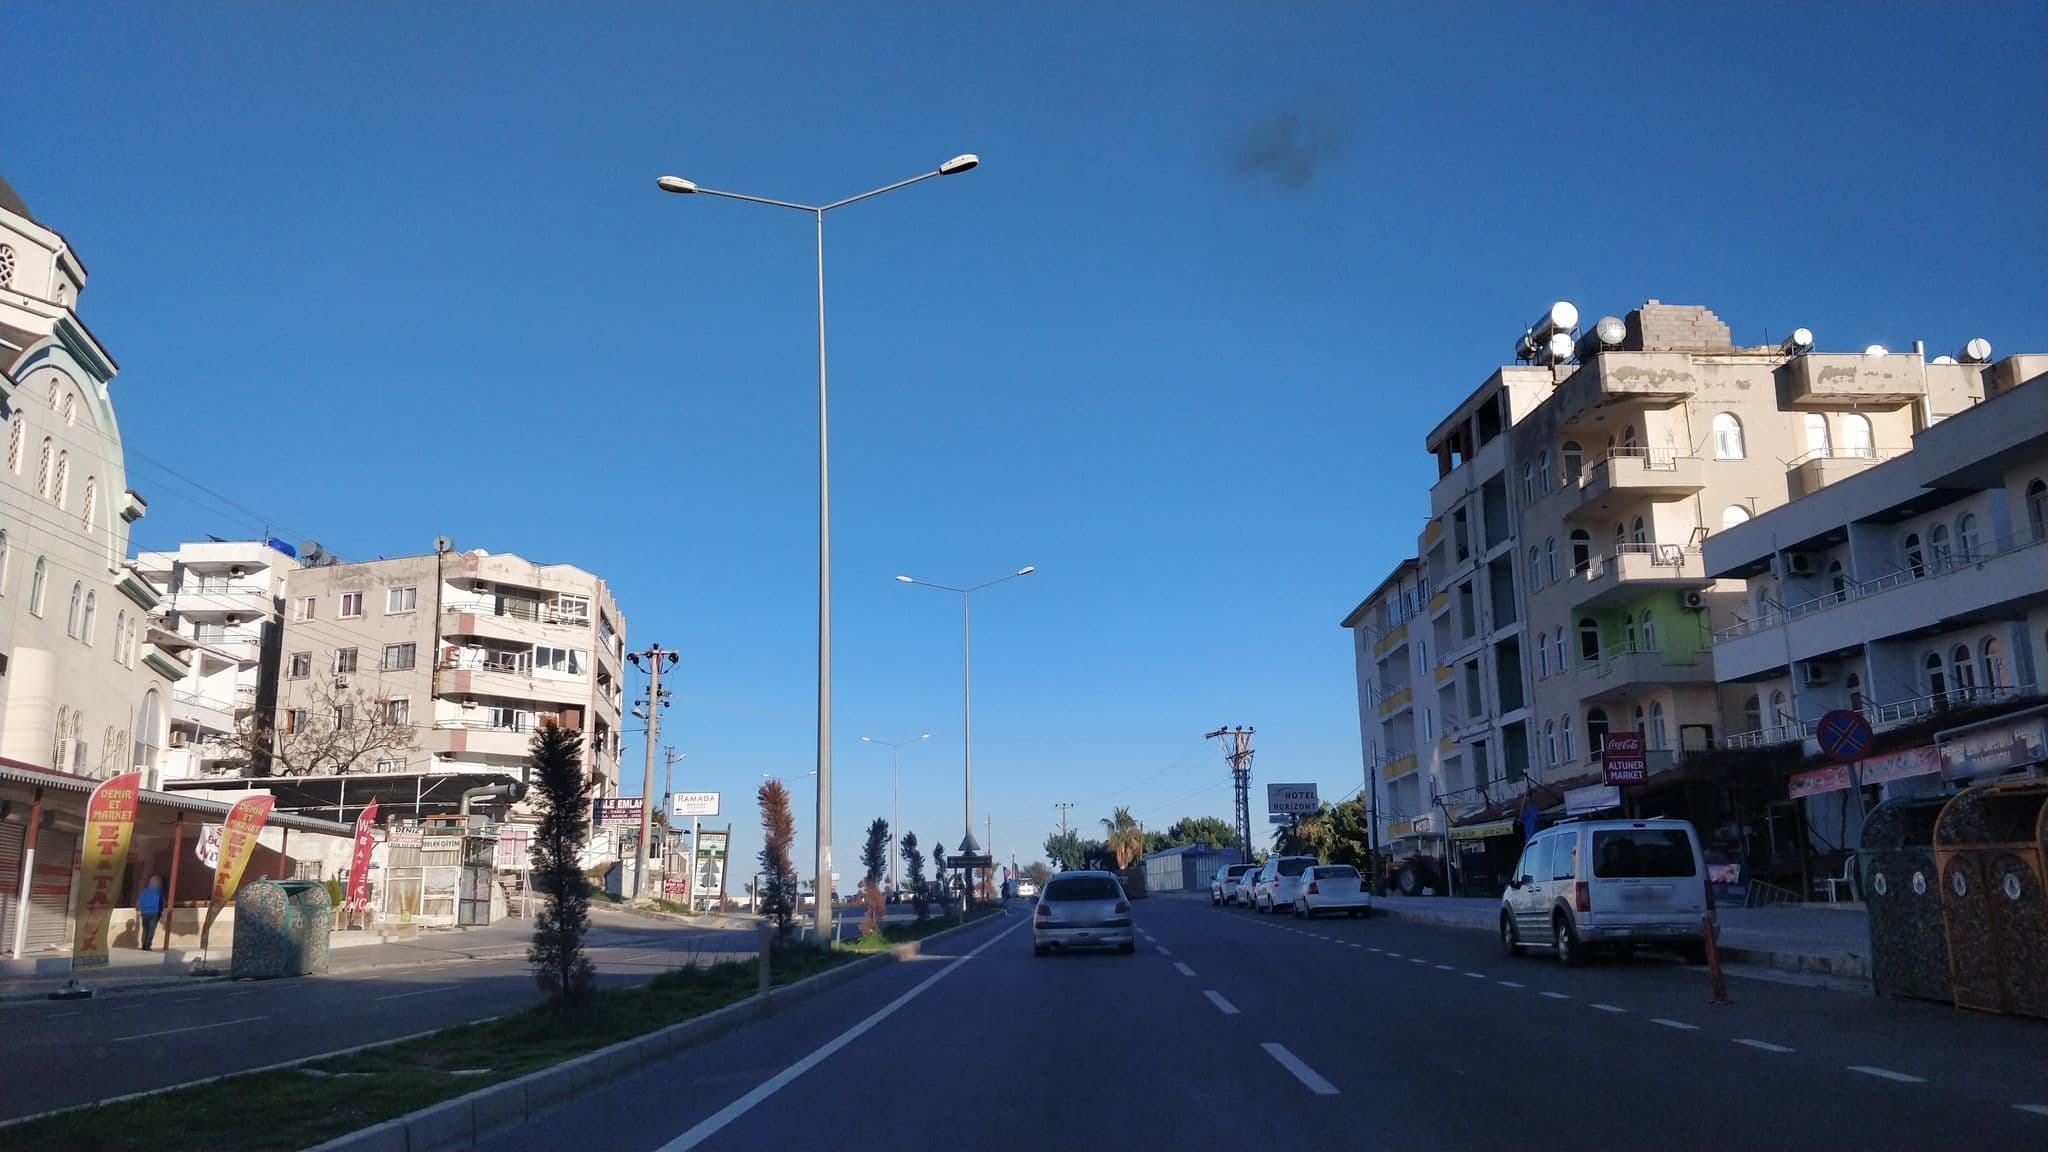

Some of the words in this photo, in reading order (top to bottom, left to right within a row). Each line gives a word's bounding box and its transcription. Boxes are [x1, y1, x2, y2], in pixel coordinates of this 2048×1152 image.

[1608, 761, 1644, 770] ALTUNER
[1610, 771, 1643, 780] MARKET
[1285, 791, 1316, 799] HOTEL
[109, 800, 121, 810] ET
[93, 810, 134, 820] MARKET
[242, 814, 254, 822] ET
[230, 818, 261, 833] MARKET
